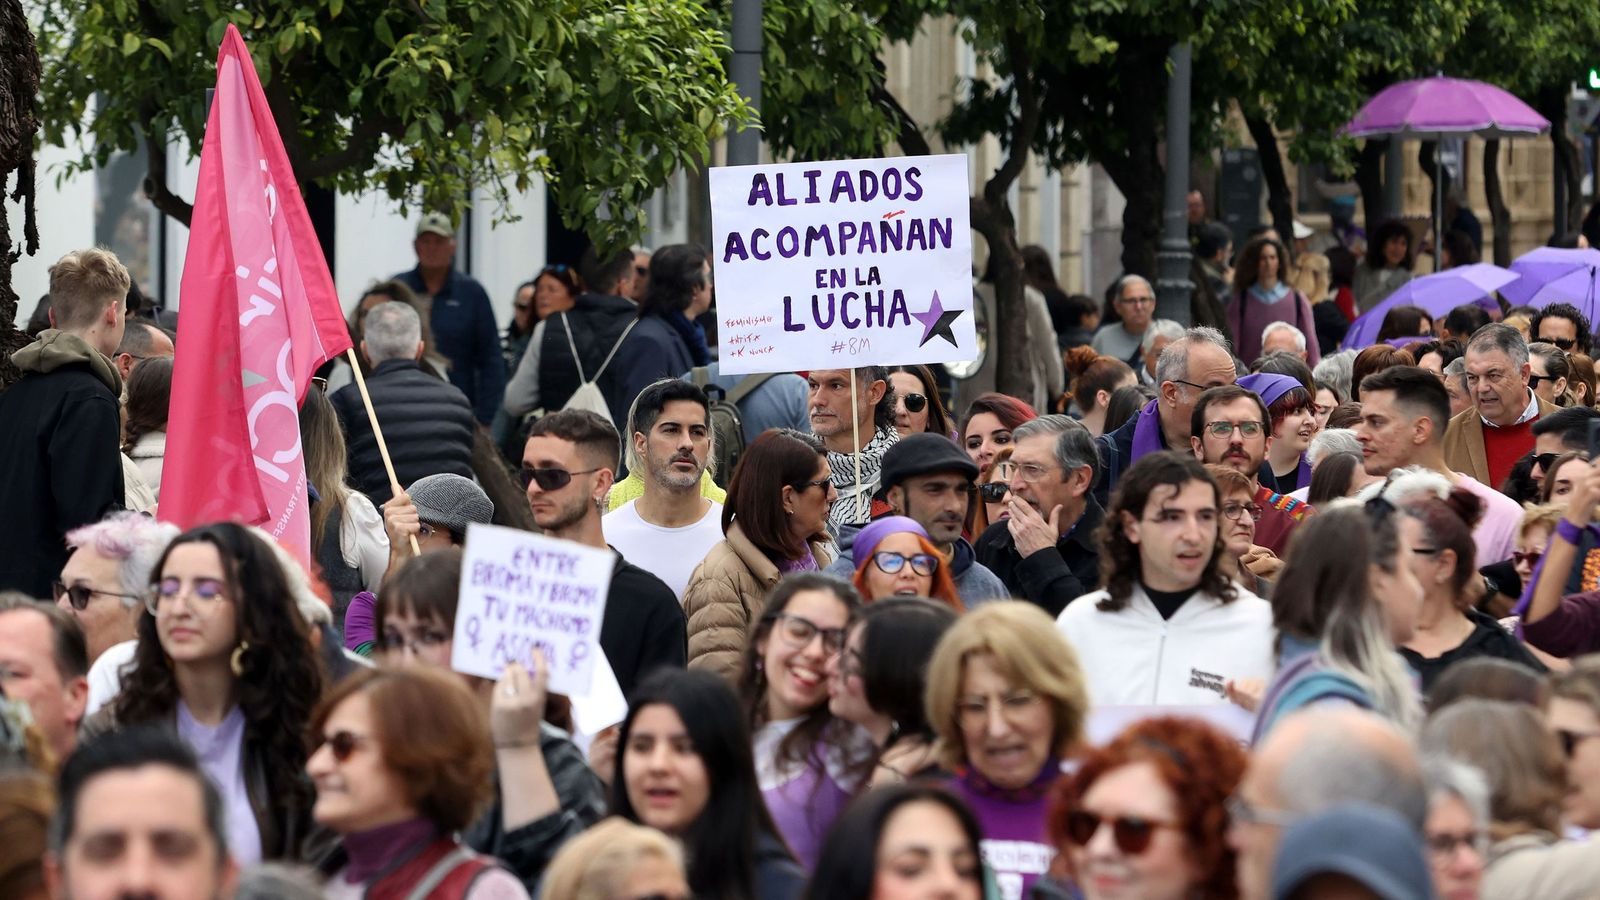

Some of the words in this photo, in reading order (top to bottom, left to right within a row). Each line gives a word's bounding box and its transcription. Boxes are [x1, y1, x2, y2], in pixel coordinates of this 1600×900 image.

[748, 167, 923, 206] ALIADOS
[723, 210, 952, 263] ACOMPAÑAN
[815, 268, 846, 288] EN
[855, 266, 881, 285] LA
[725, 315, 772, 328] FEMINISMO
[783, 289, 911, 331] LUCHA
[749, 346, 774, 355] NUNCA
[831, 337, 870, 355] #8M
[512, 546, 580, 576] ENTRE
[484, 594, 508, 621] TU
[514, 602, 589, 634] MACHISMO
